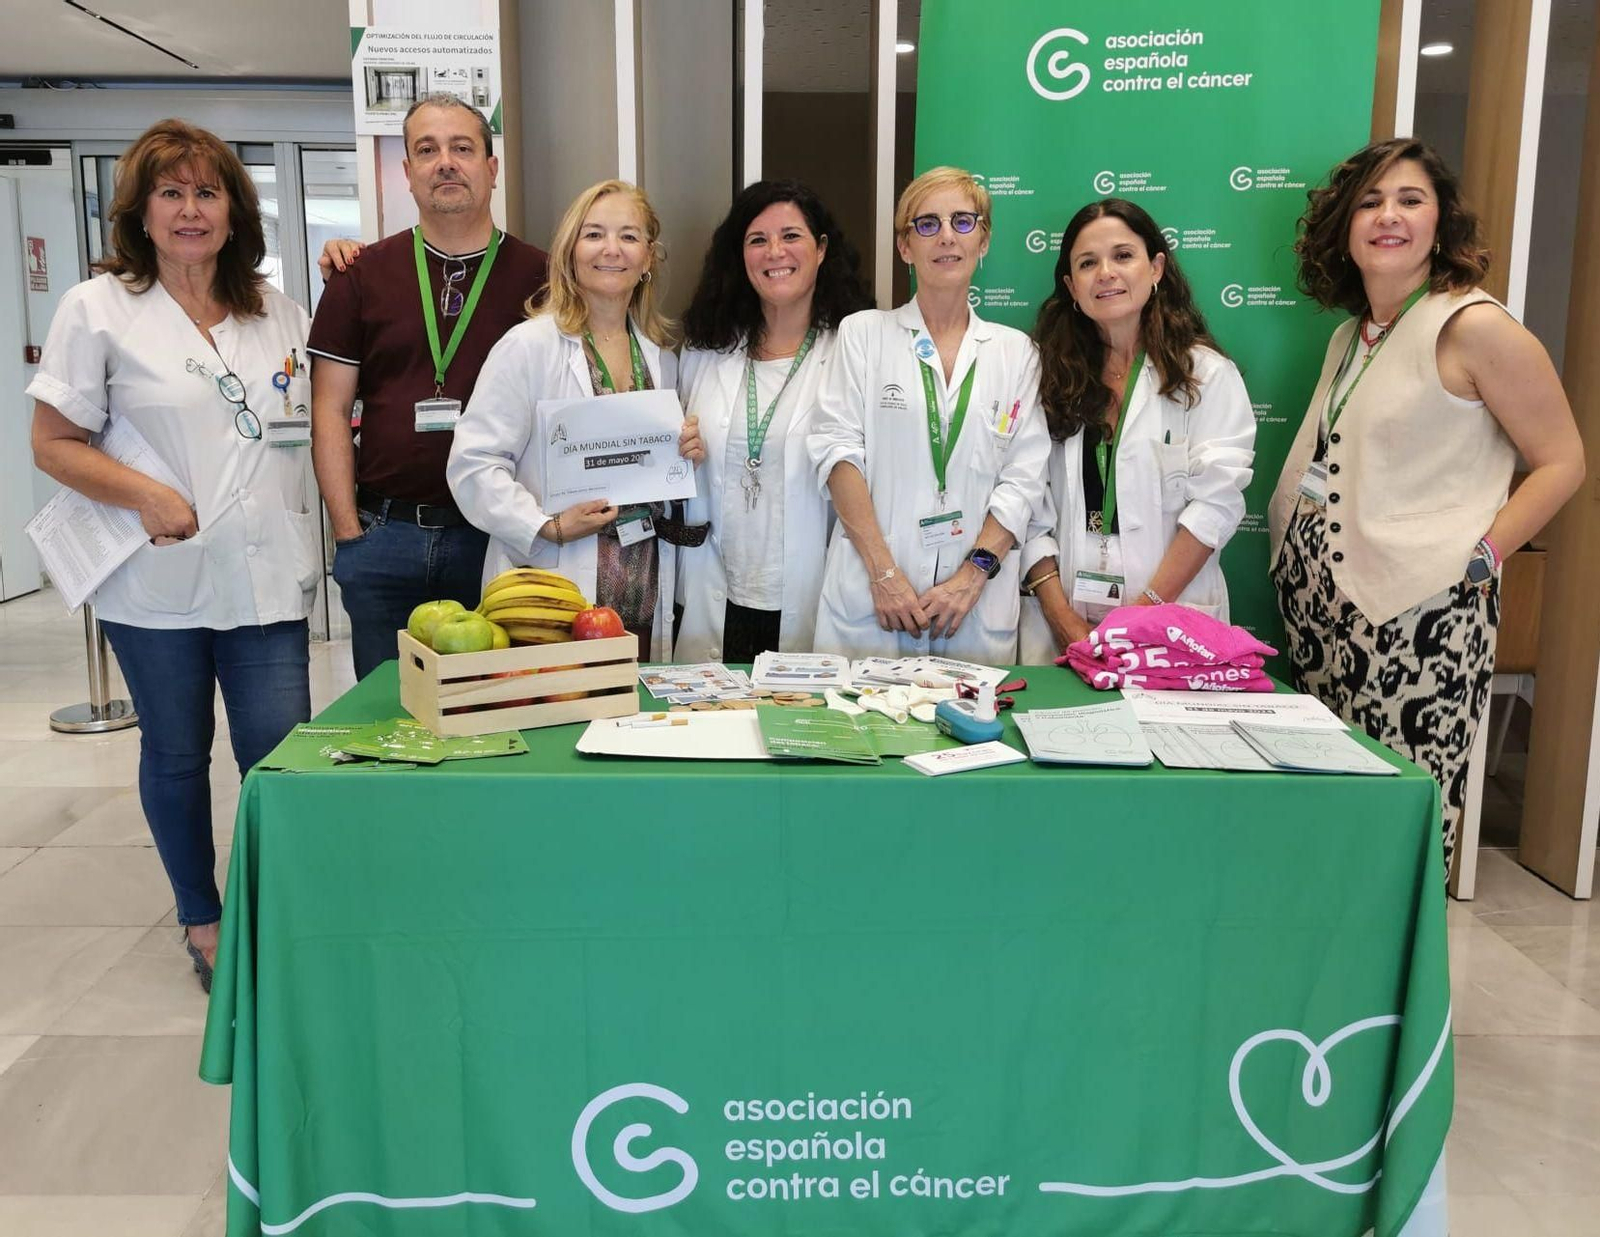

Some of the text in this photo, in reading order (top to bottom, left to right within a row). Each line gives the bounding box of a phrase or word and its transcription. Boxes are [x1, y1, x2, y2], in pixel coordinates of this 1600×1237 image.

[1105, 29, 1204, 50] asociación
[1104, 52, 1188, 73] española
[1102, 70, 1253, 93] contra el cáncer
[564, 434, 672, 454] DÍA MUNDIAL SIN TABACO
[585, 458, 595, 467] 31
[597, 457, 606, 466] de
[608, 456, 629, 466] mayo
[724, 1091, 912, 1121] asociación
[726, 1131, 886, 1166] española
[726, 1168, 1010, 1200] contra el cáncer
